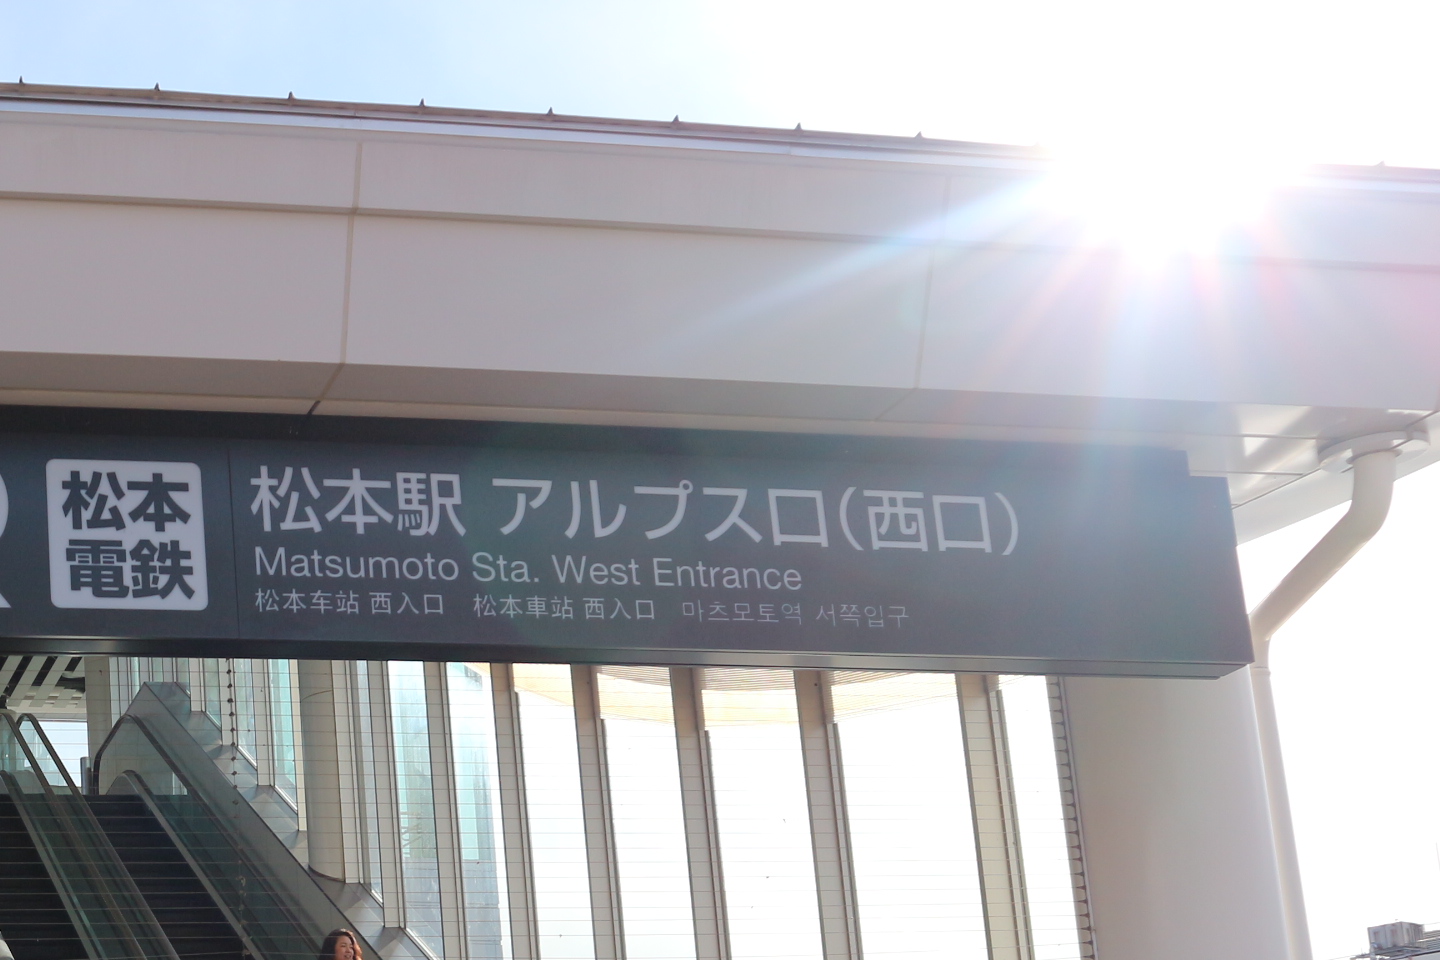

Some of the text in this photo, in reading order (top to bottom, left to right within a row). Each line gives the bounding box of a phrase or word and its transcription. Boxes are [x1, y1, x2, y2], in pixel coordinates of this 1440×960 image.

[62, 470, 191, 532] 松本
[249, 464, 466, 537] 松本駅
[66, 539, 195, 600] 電鉄
[254, 545, 802, 591] Matsumoto Sta. West Entrance
[254, 587, 444, 616] 松本车站 西入口
[472, 593, 656, 621] 松本車站 西入口
[682, 599, 803, 626] 마츠모토역
